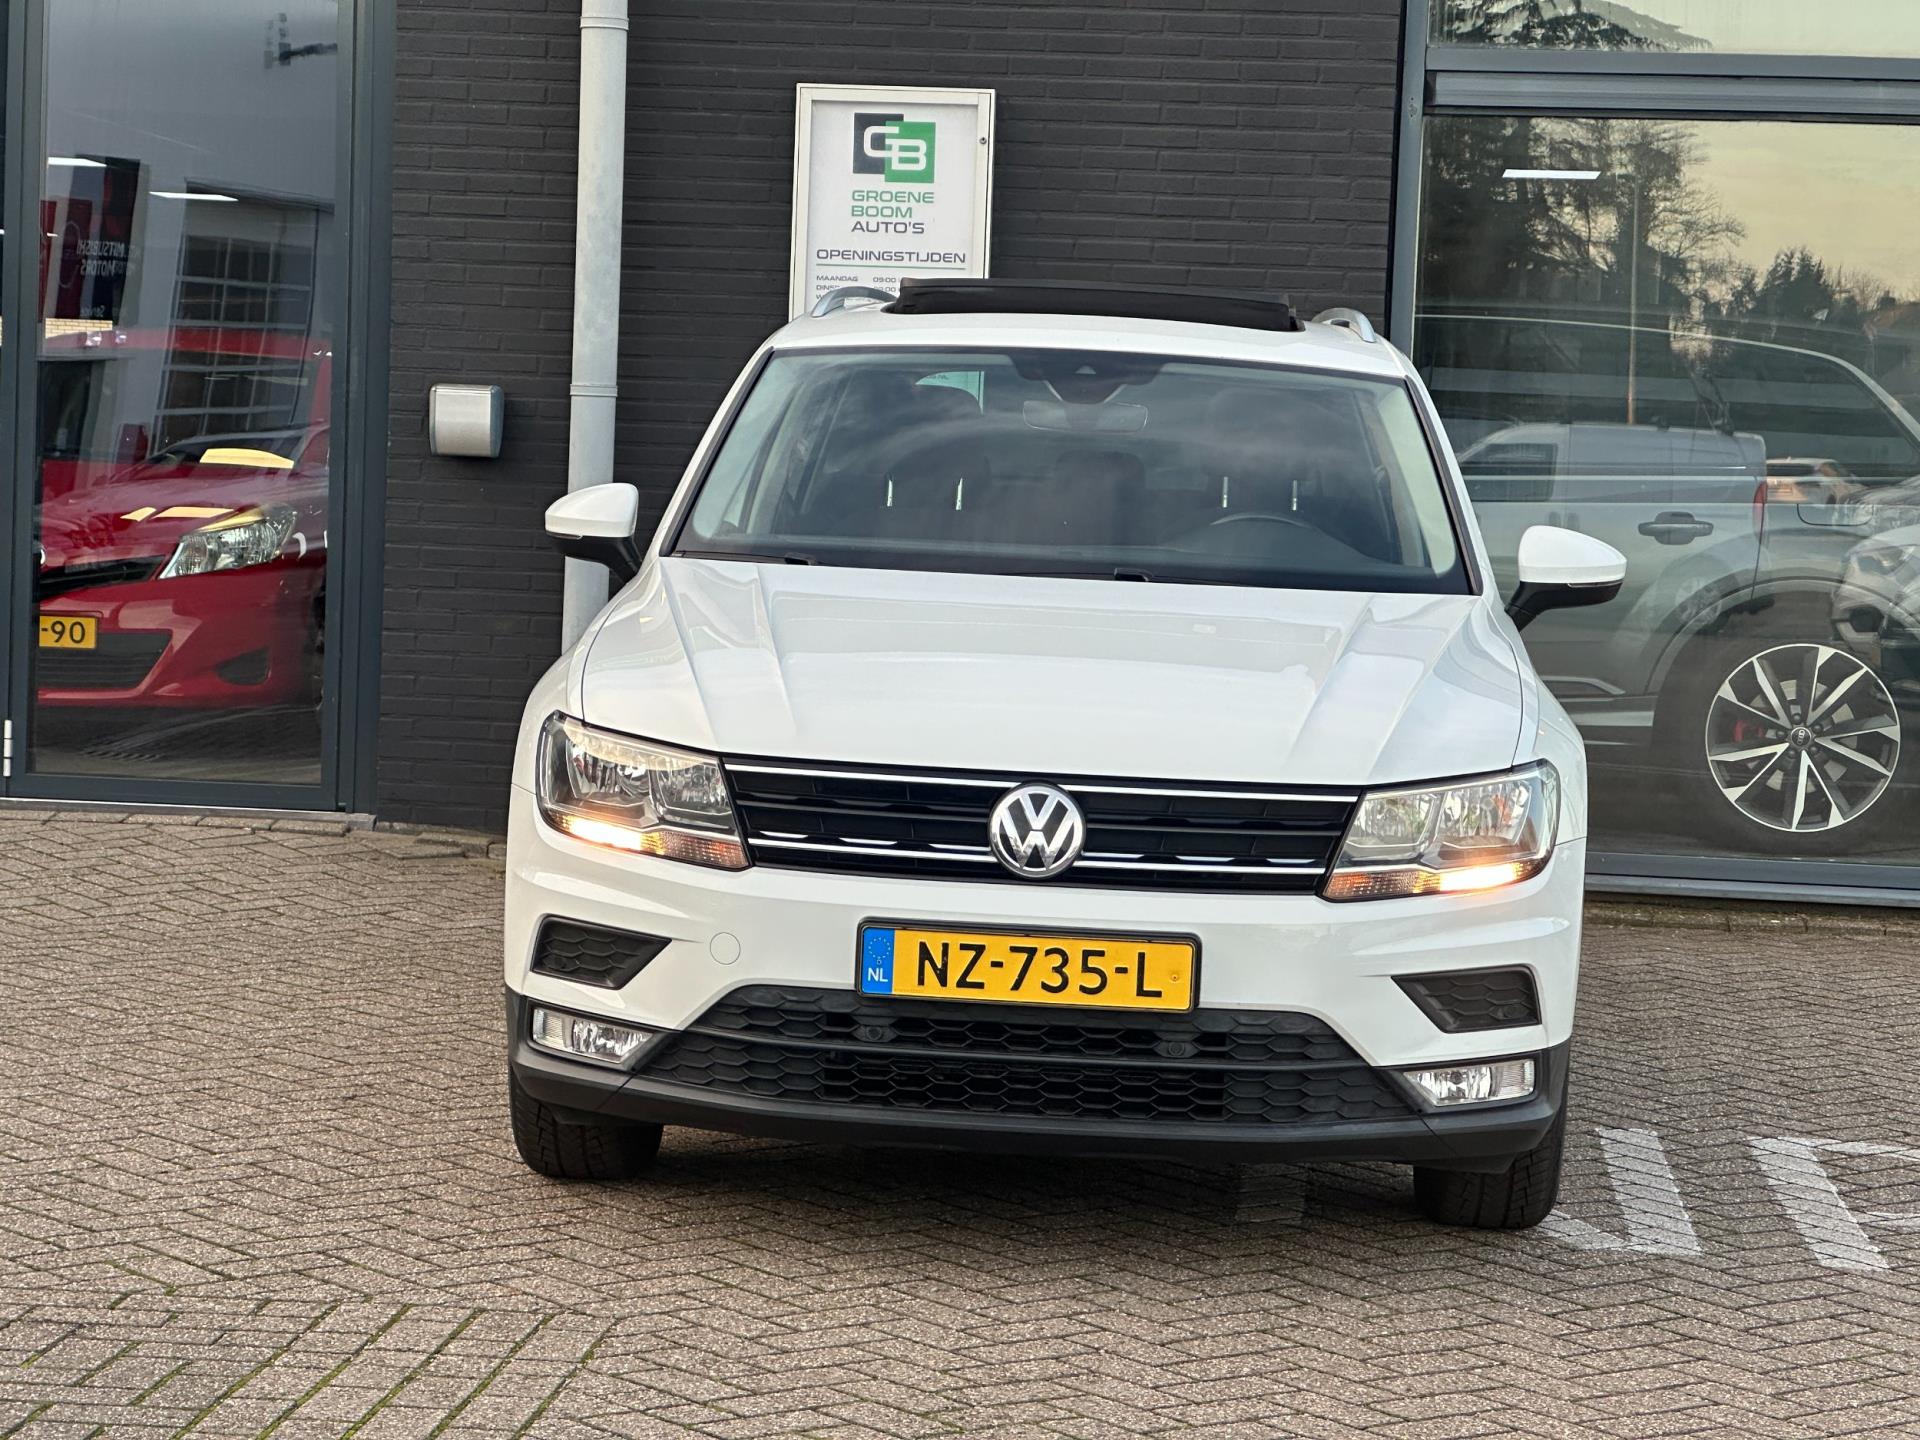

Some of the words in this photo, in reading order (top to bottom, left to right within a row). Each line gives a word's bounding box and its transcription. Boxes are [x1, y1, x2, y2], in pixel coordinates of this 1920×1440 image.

[852, 190, 935, 204] GROENE
[851, 205, 913, 218] BOOM
[851, 221, 925, 234] AUTO'S
[816, 249, 966, 264] OPENINGSTIJDEN
[867, 967, 889, 982] NL
[916, 940, 1163, 998] NZ-735-L
